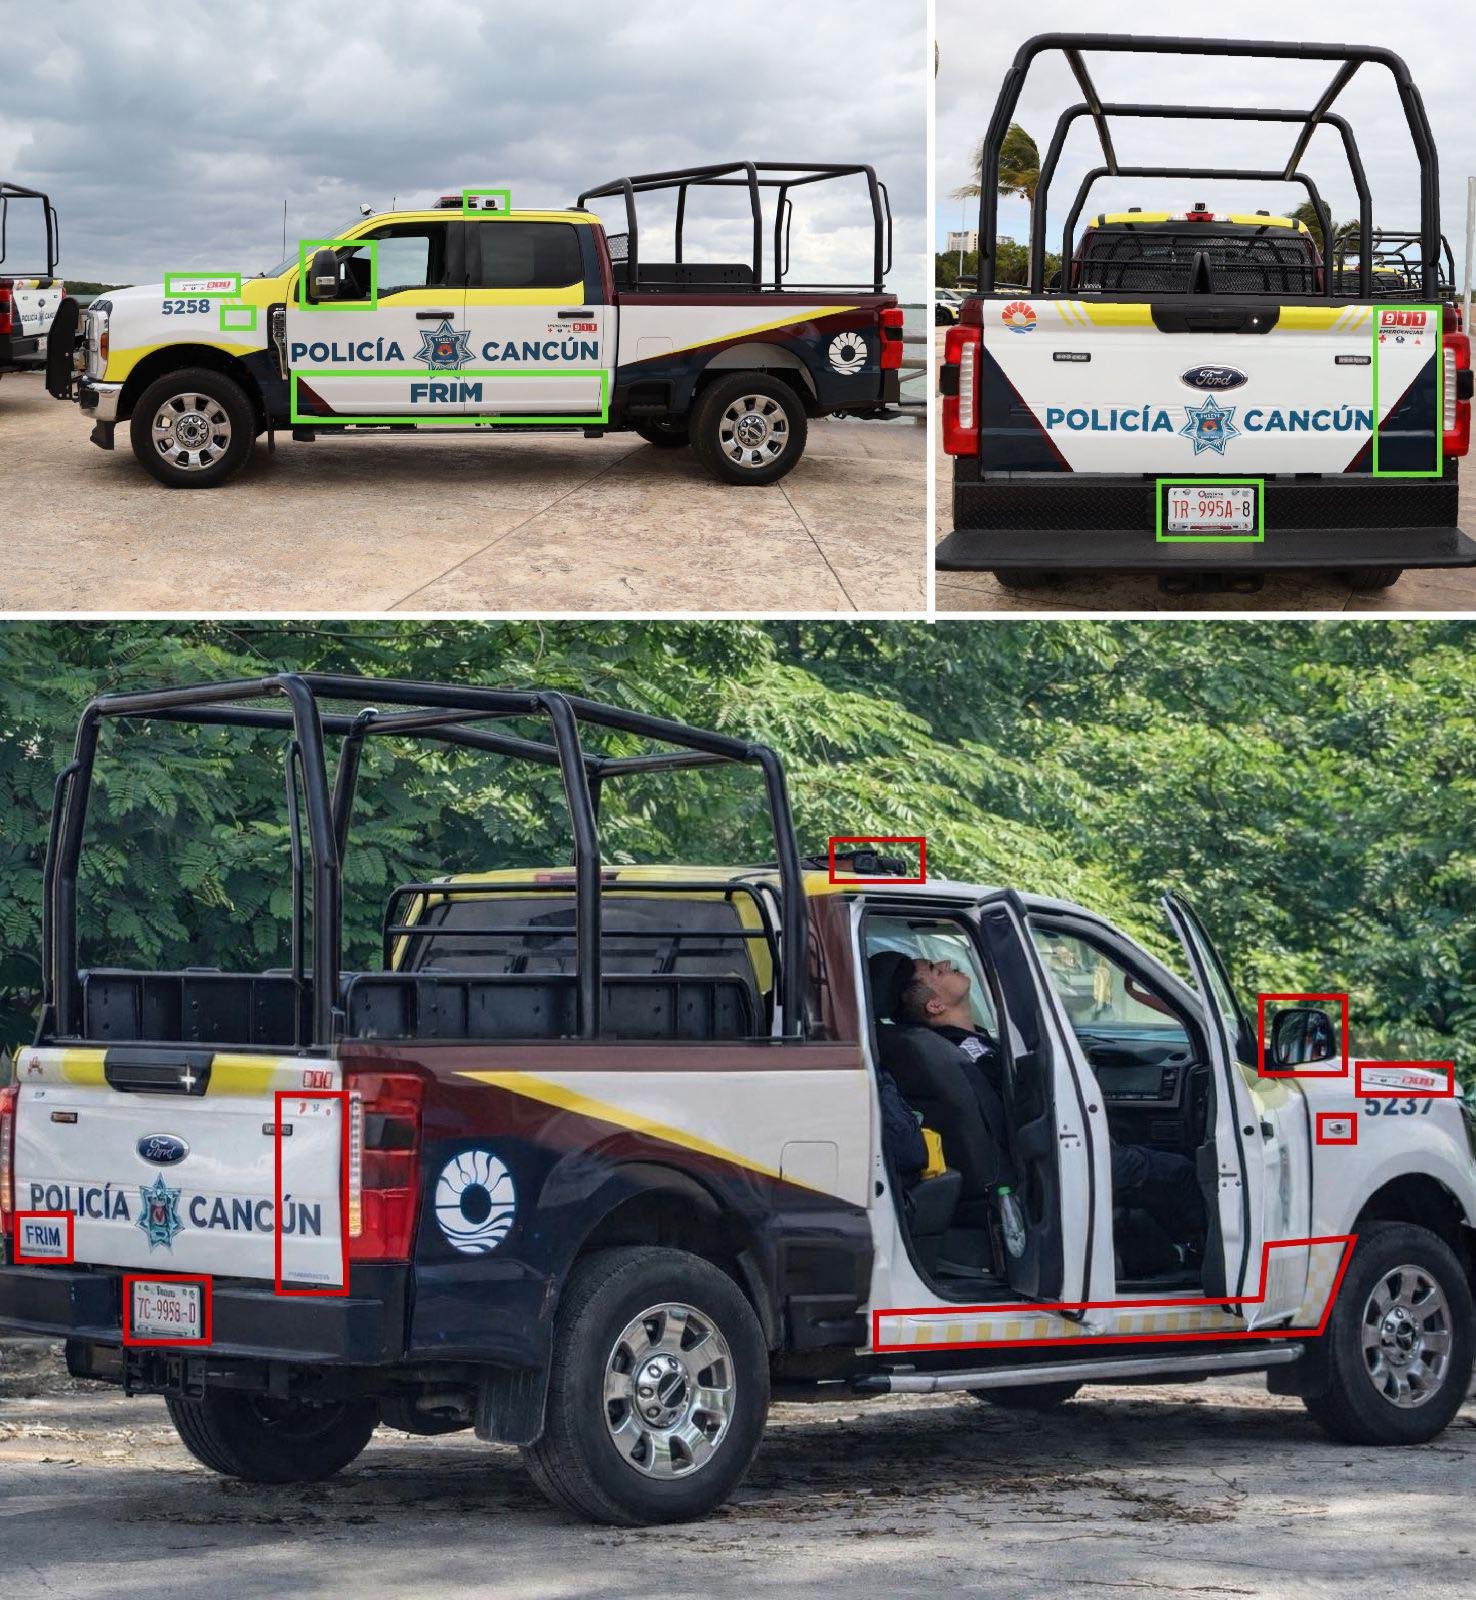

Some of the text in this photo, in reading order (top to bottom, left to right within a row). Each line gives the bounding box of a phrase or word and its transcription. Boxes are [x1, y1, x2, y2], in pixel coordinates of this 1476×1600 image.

[162, 299, 210, 315] 5258
[1384, 312, 1424, 324] 911
[291, 337, 599, 363] POLICÍA CANCÚN
[1196, 370, 1233, 386] Ford
[410, 383, 483, 404] FRIM
[1046, 404, 1374, 432] POLICÍA CANCÚN
[1172, 500, 1251, 518] TR-995A-8
[30, 1182, 322, 1238] POLICÍA CANCÚN
[25, 1225, 61, 1247] FRIM
